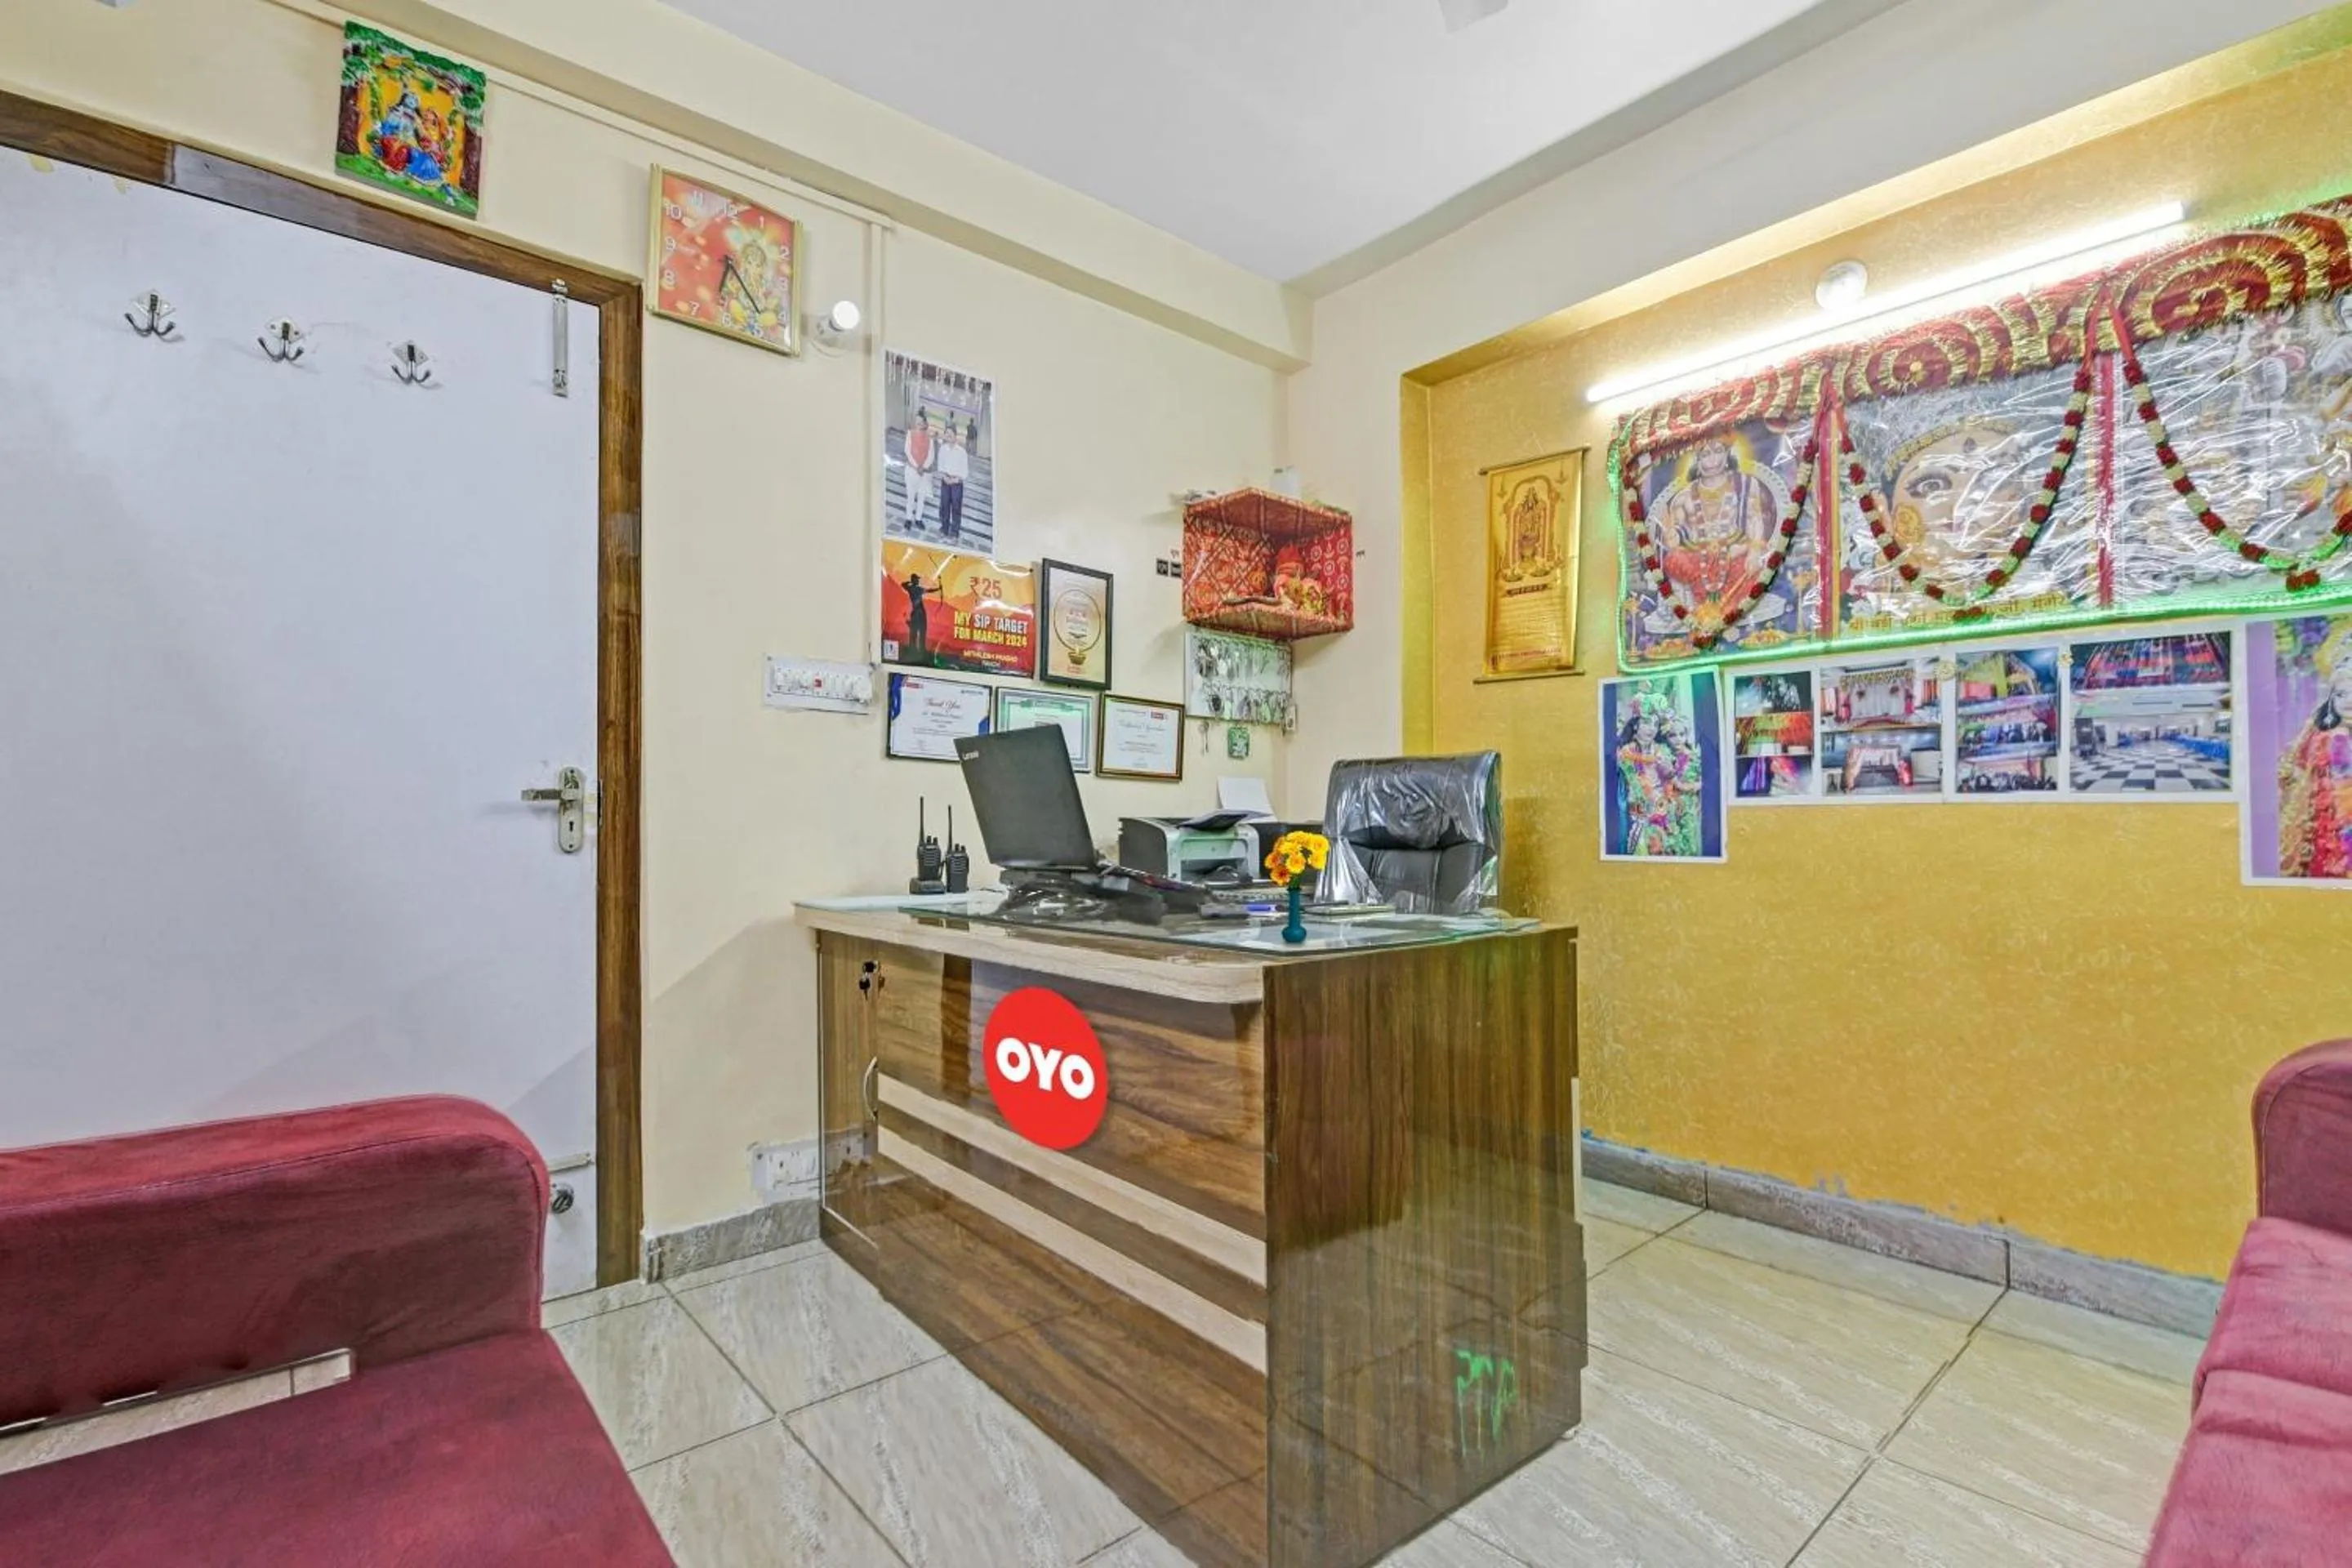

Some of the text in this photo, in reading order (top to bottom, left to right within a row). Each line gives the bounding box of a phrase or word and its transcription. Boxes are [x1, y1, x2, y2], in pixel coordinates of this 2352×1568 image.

[666, 205, 682, 220] 10
[759, 215, 765, 229] 1
[666, 236, 676, 251] 9
[778, 245, 791, 261] 2
[665, 270, 675, 286] 8
[688, 300, 700, 316] 7
[954, 611, 1029, 635] MY SIP TARGET
[954, 626, 1028, 648] FOR MARCH 2024
[996, 1037, 1095, 1100] OYO
